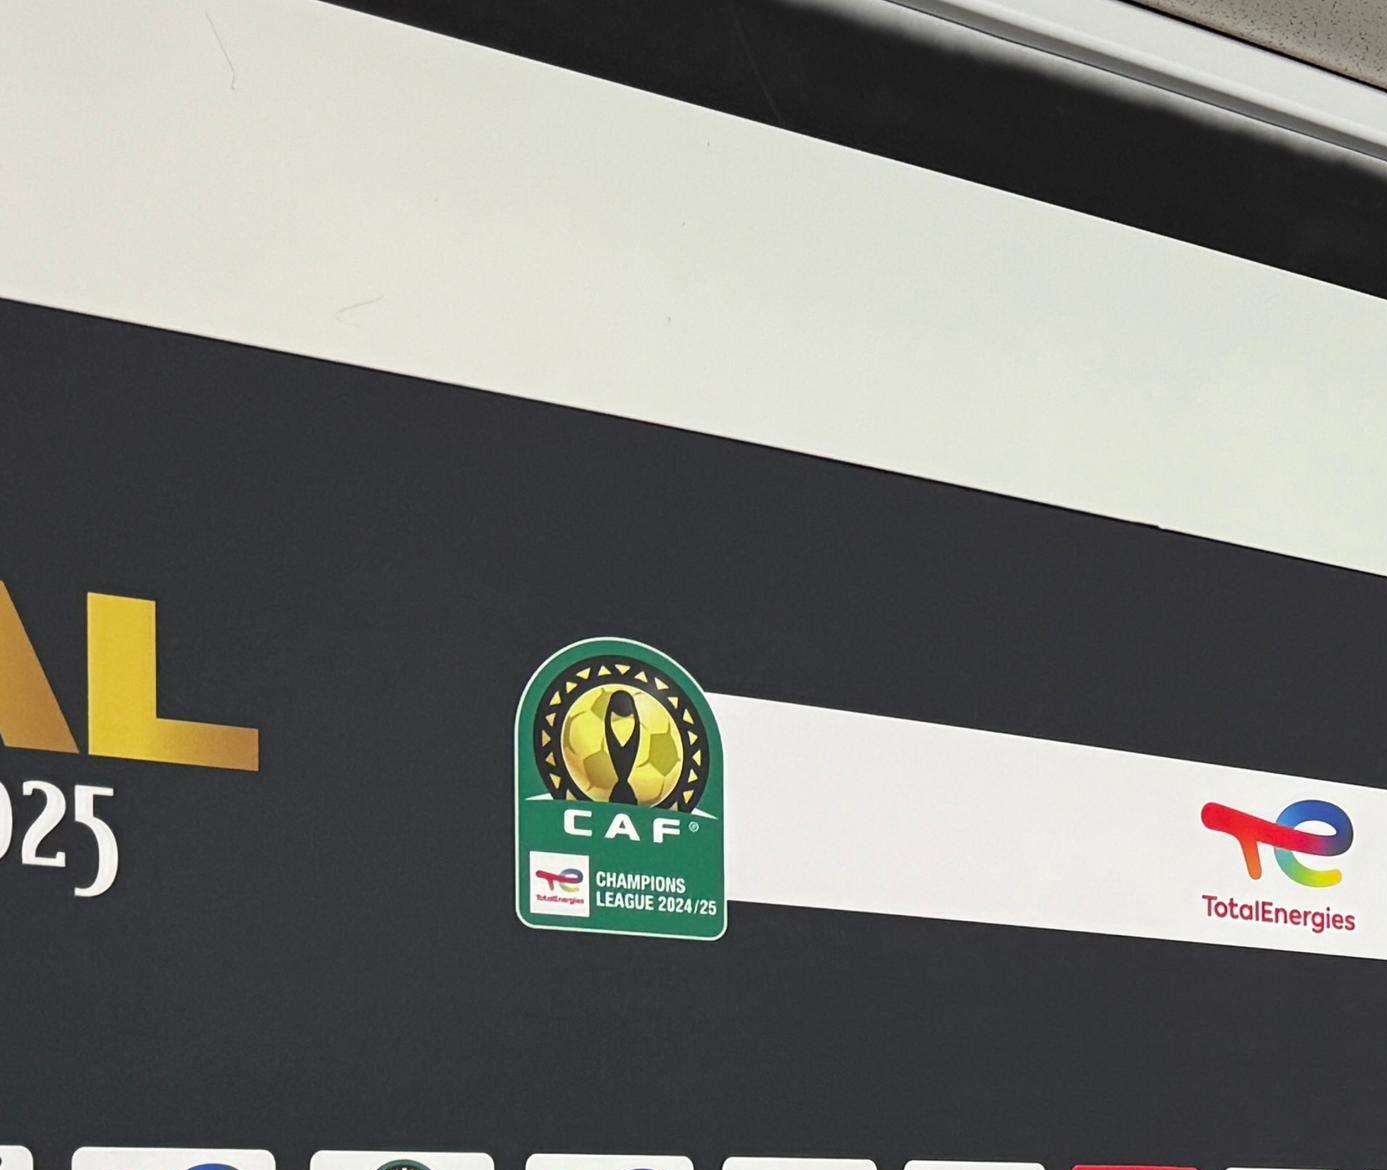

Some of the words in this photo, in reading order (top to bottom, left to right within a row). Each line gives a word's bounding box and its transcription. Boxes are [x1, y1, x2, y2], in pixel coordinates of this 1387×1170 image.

[563, 809, 681, 844] CAF
[596, 871, 686, 894] CHAMPIONS
[596, 891, 654, 911] LEAGUE
[658, 898, 717, 916] 2024/25
[1202, 894, 1357, 933] TotalEnergies
